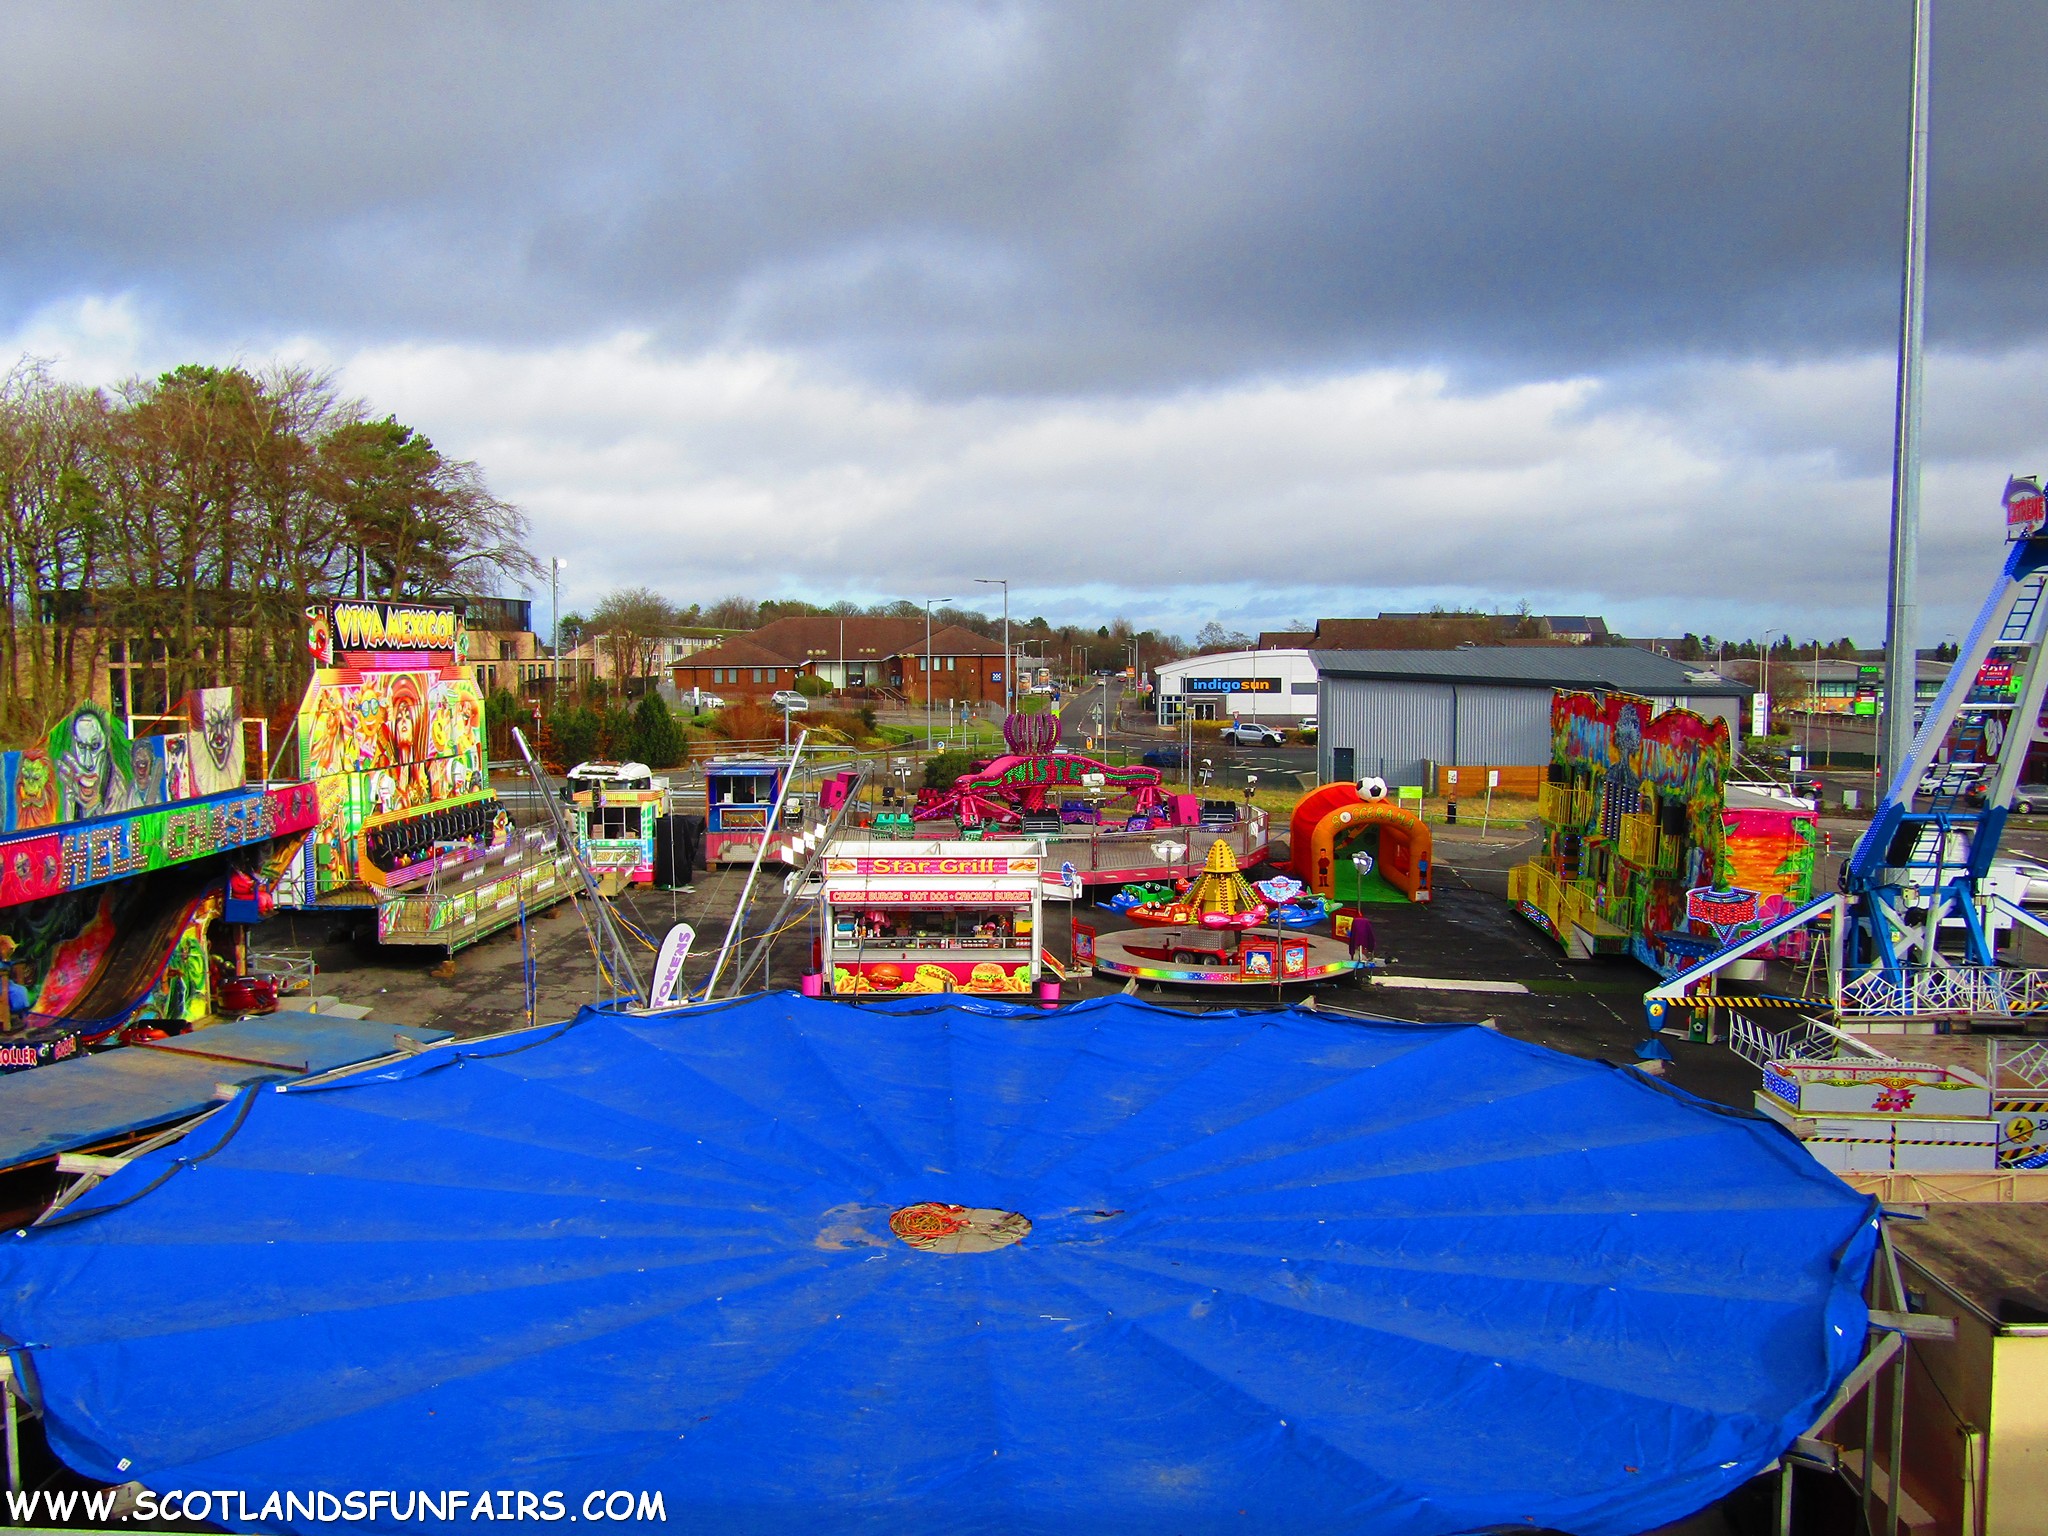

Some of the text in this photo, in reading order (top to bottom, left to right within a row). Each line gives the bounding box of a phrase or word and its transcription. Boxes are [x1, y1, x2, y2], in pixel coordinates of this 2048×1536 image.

[334, 603, 455, 650] VIVA MEXICO!
[1193, 679, 1270, 693] indigosun
[1563, 825, 1580, 834] FUN
[59, 793, 278, 889] HELL CHASER
[873, 859, 931, 874] Star
[939, 859, 995, 874] Grill
[1653, 869, 1673, 878] FUN
[832, 891, 1030, 901] CHEESE BURGER HOT DOG CHICKEN BURGER
[654, 932, 691, 1008] TOKENS
[0, 1047, 38, 1066] OLLER
